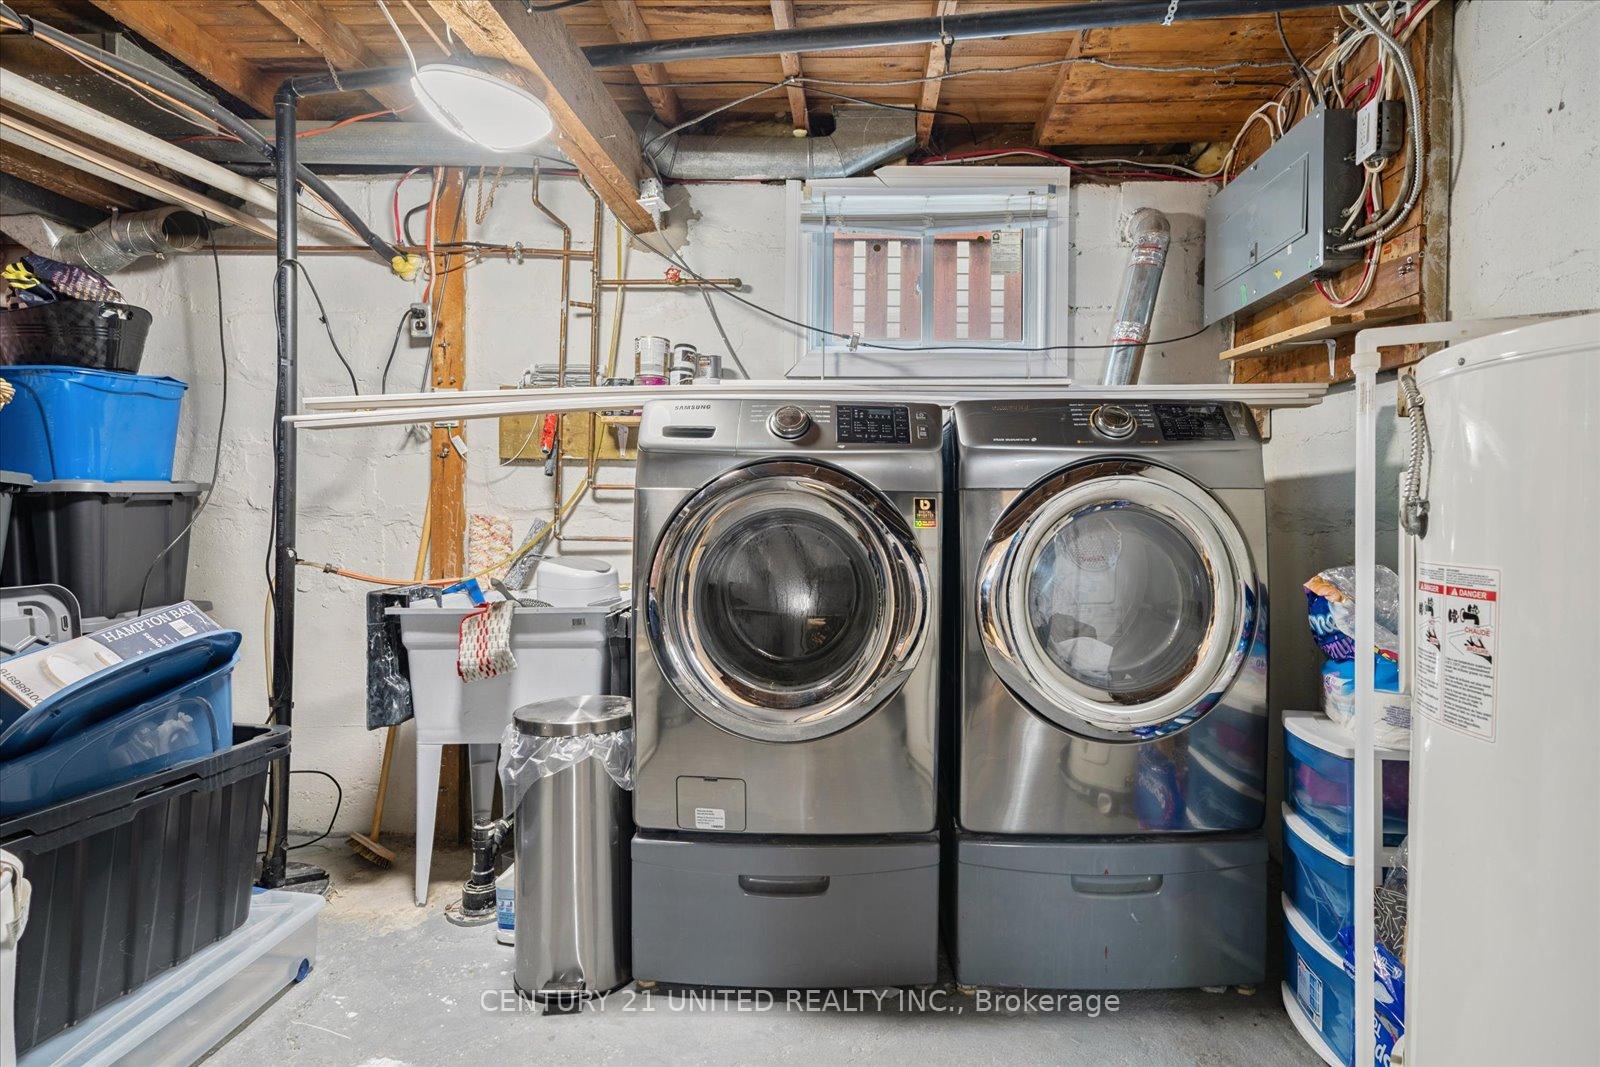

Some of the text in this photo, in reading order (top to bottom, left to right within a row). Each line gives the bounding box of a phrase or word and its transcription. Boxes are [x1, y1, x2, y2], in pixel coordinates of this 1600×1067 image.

[1459, 588, 1488, 600] DANGER
[101, 613, 172, 643] HAMPTON
[169, 604, 196, 619] BAY
[1464, 626, 1491, 638] CHAUDE
